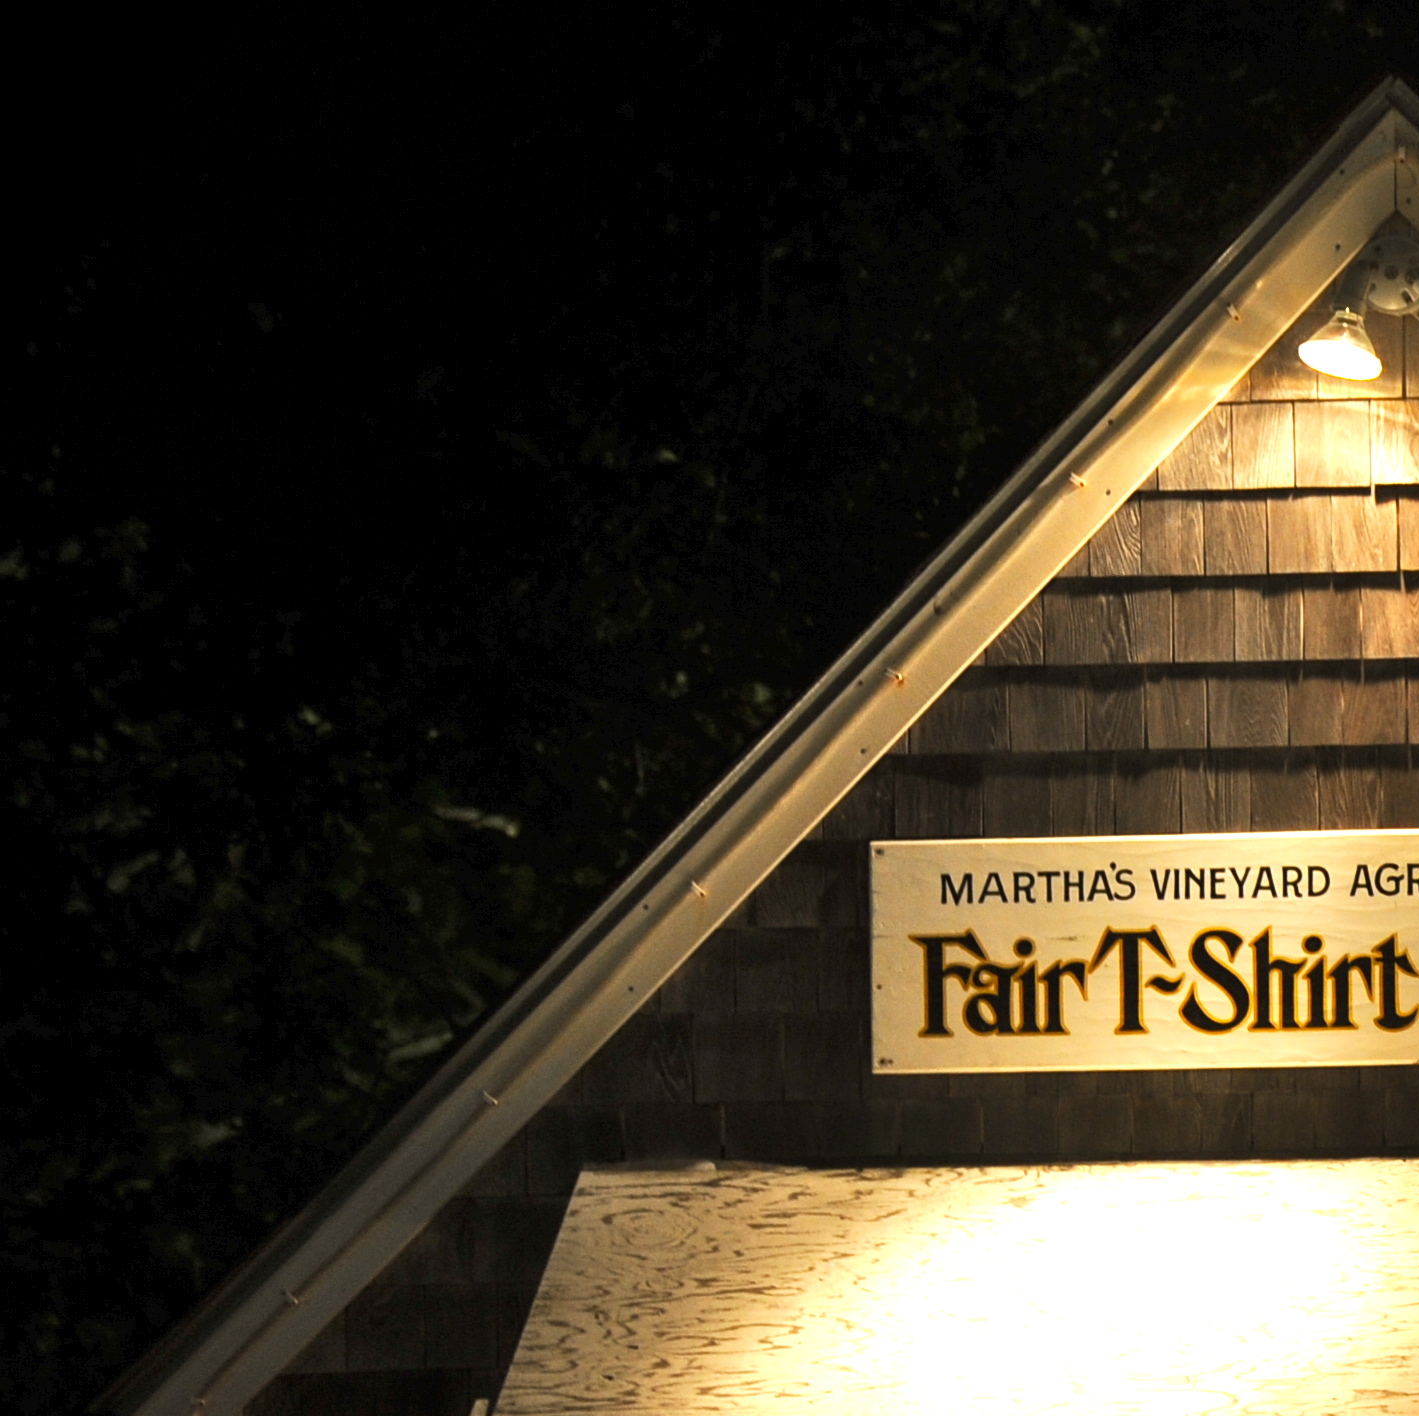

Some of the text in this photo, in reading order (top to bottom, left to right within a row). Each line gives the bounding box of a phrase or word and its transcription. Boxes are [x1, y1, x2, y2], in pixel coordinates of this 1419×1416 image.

[939, 862, 1137, 906] MARTHA'S
[1149, 866, 1332, 901] VINEYARD
[906, 927, 1088, 1038] Fair
